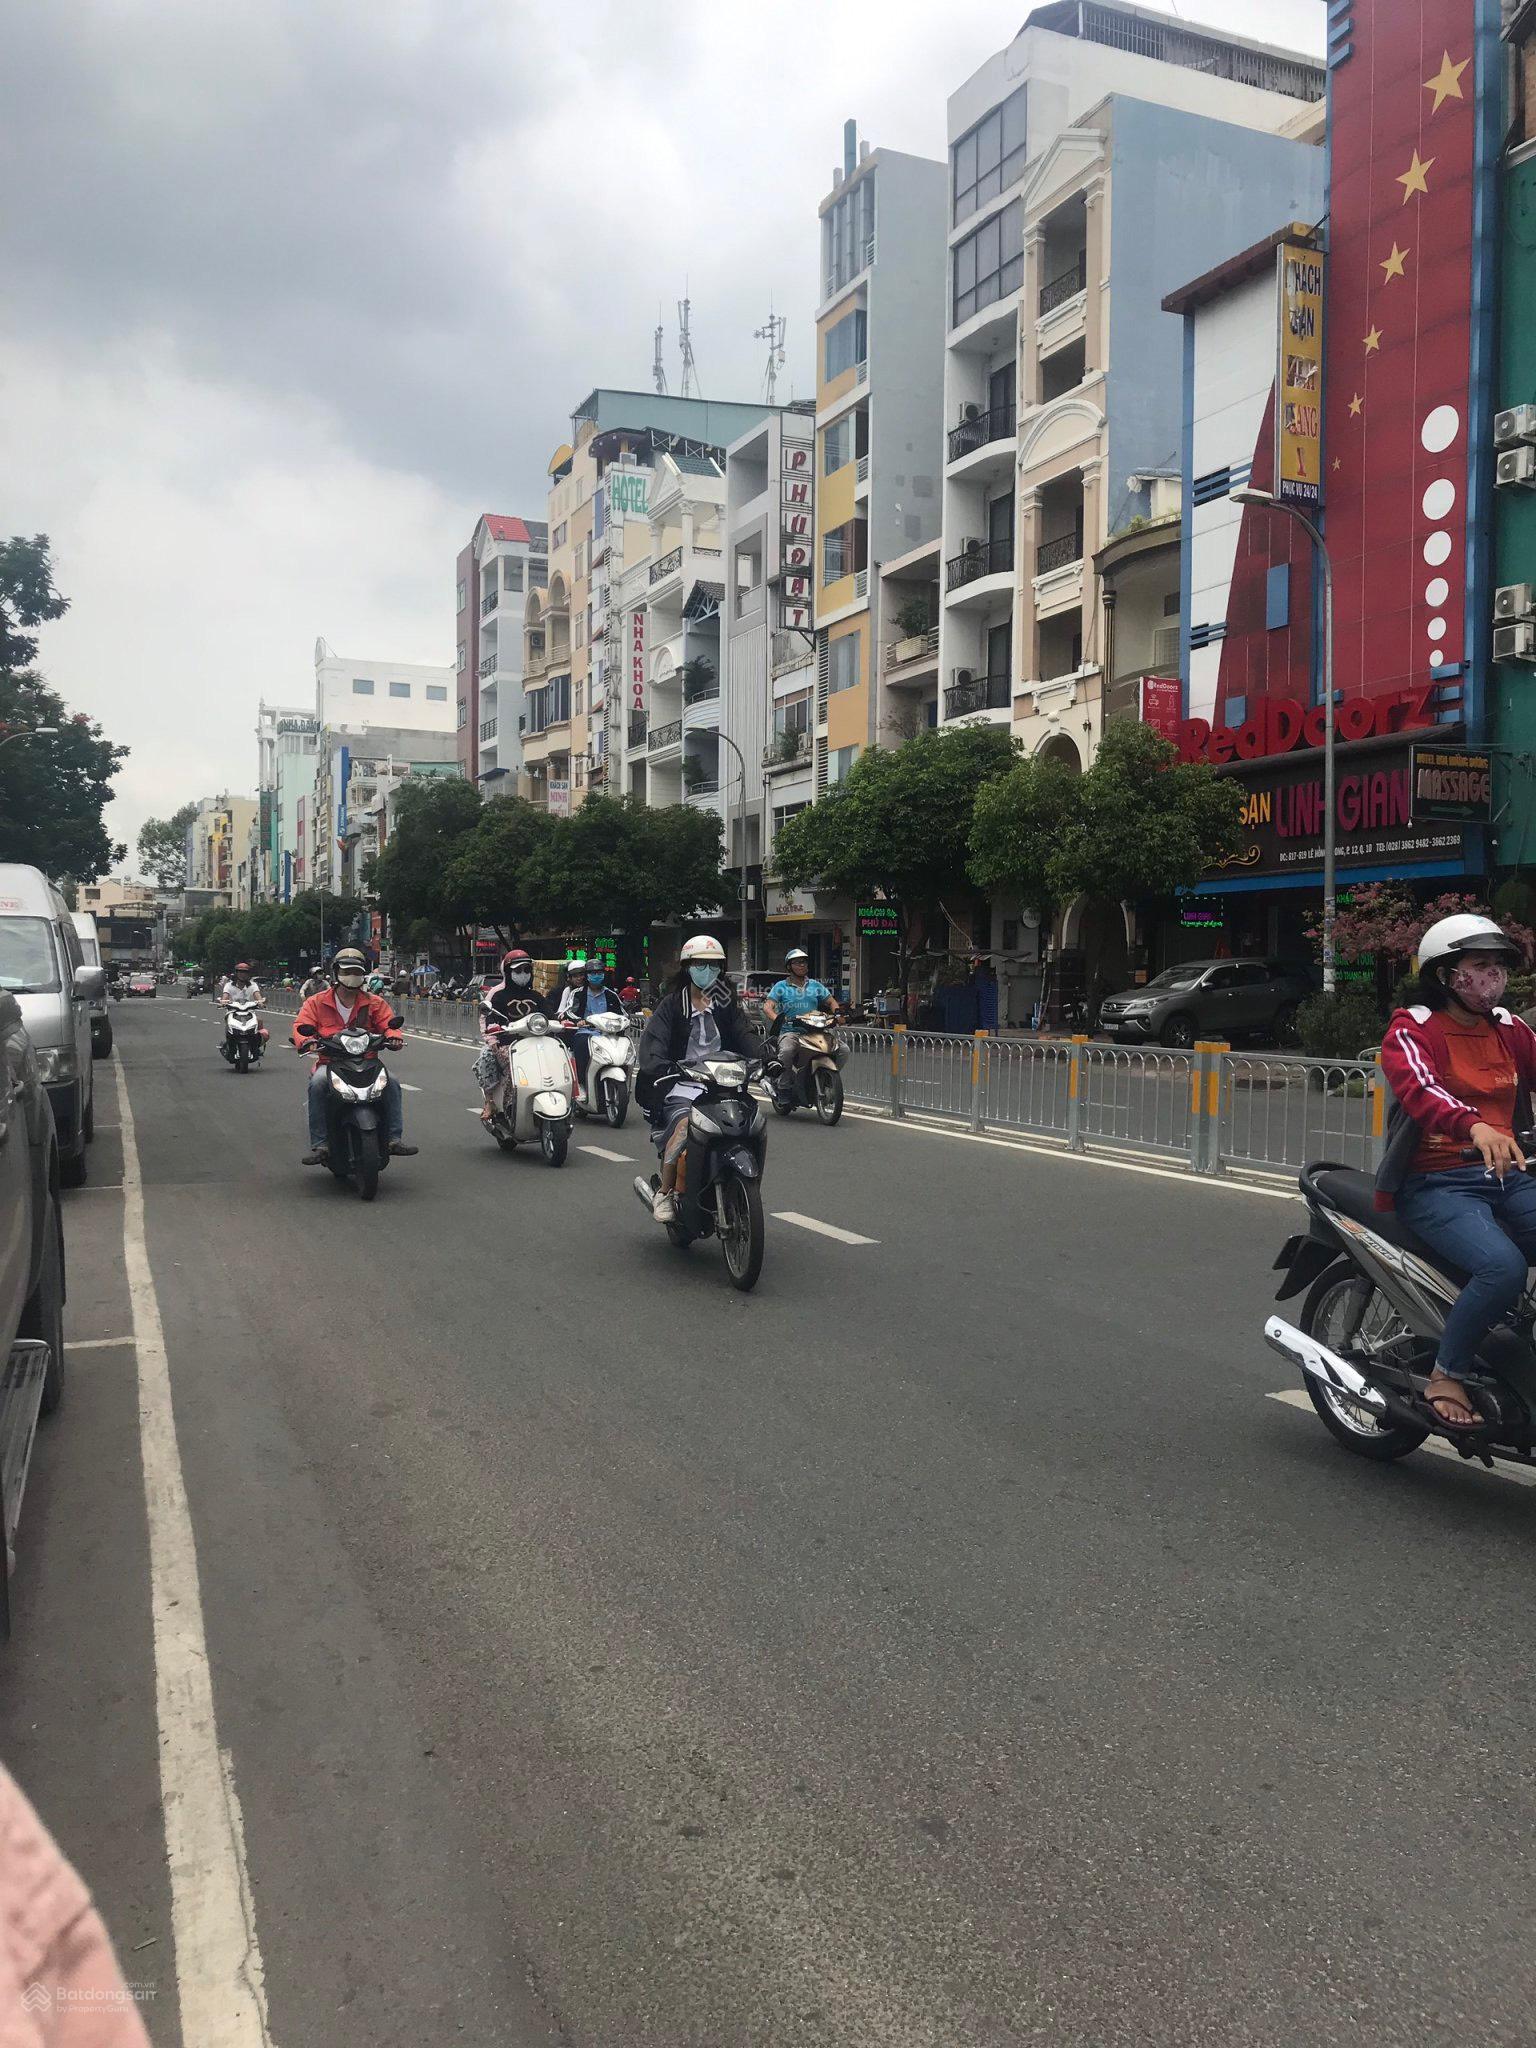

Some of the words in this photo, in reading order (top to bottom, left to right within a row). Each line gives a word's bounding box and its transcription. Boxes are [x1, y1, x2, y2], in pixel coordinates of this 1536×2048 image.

[1285, 256, 1321, 296] HÁCH
[611, 474, 650, 515] HOTEL
[632, 613, 645, 653] NHA
[631, 656, 645, 710] KHOA
[1179, 685, 1435, 765] RedDoorz
[1417, 768, 1490, 804] MASSAGE
